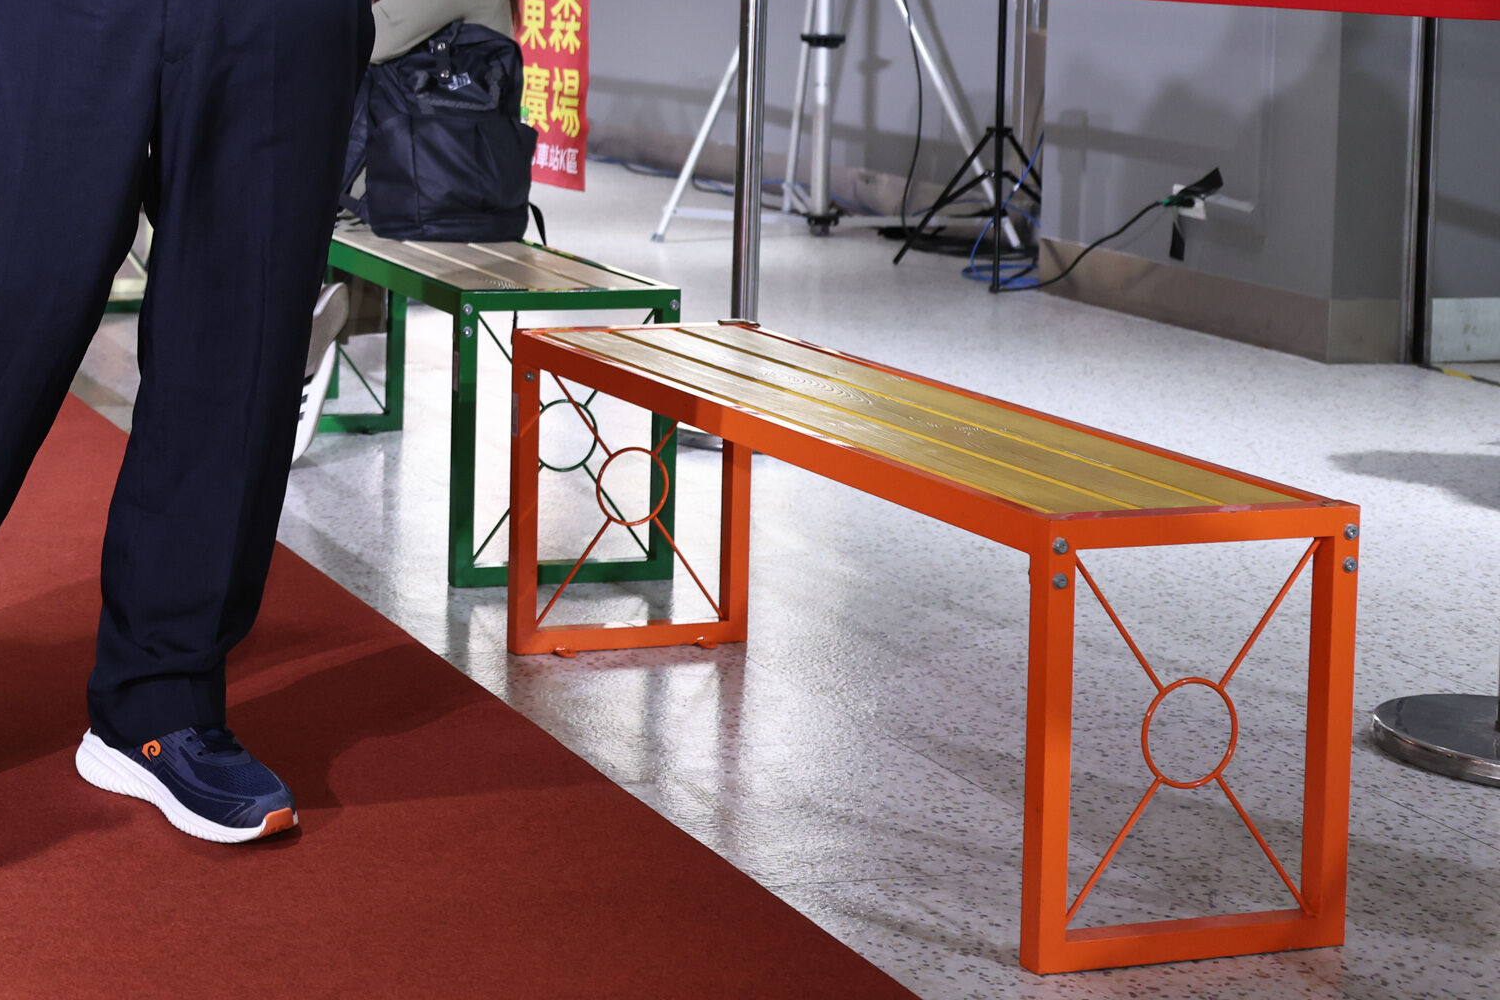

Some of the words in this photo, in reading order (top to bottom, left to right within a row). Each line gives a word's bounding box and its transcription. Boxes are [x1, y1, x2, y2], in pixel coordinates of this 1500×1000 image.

[521, 62, 582, 138] 廣場
[531, 142, 579, 175] 車站K區
